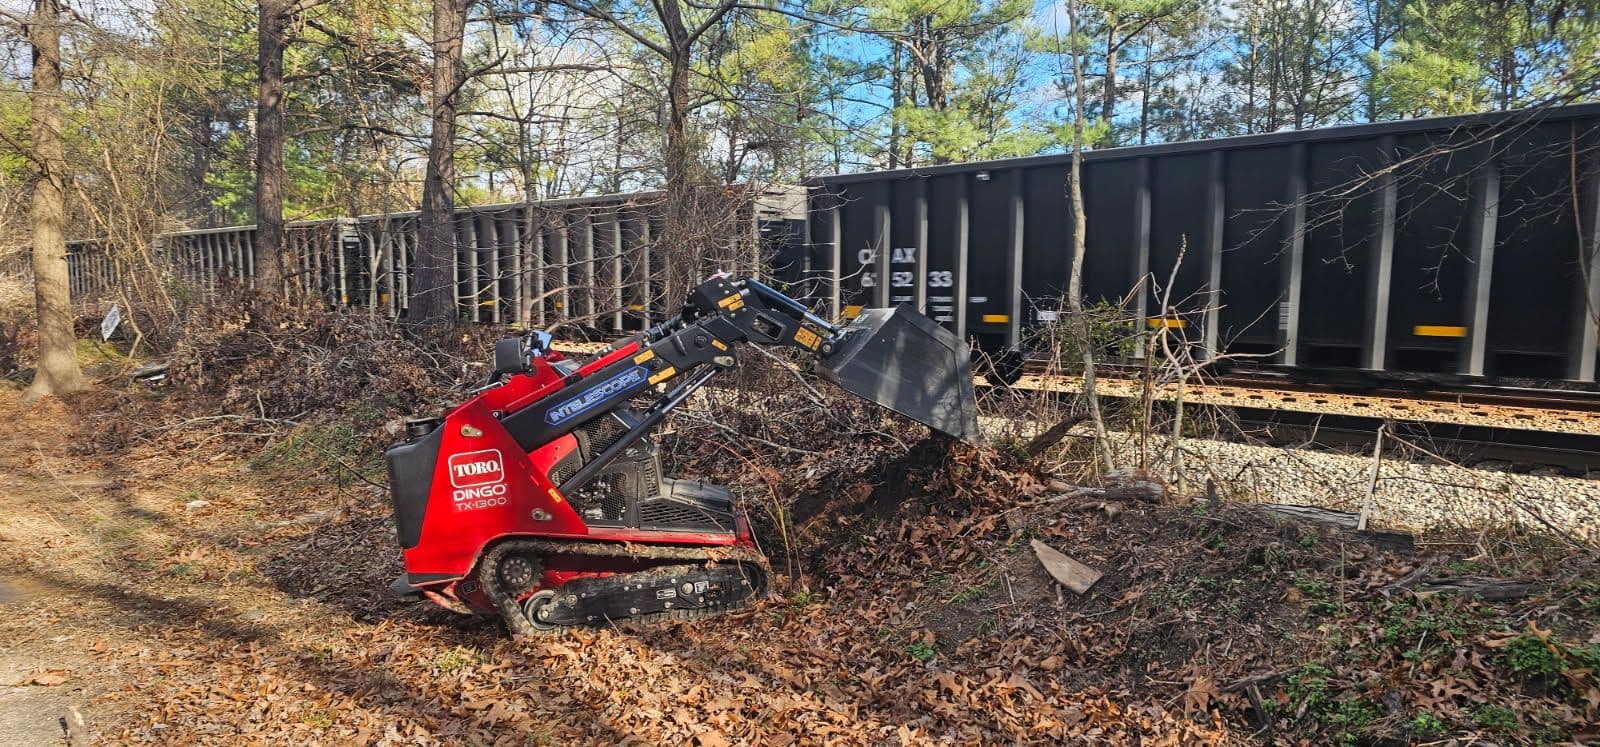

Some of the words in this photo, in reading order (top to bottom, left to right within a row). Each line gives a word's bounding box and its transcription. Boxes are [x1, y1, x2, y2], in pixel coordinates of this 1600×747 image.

[891, 271, 914, 287] 52
[928, 270, 953, 287] 33
[453, 484, 506, 501] DINGO
